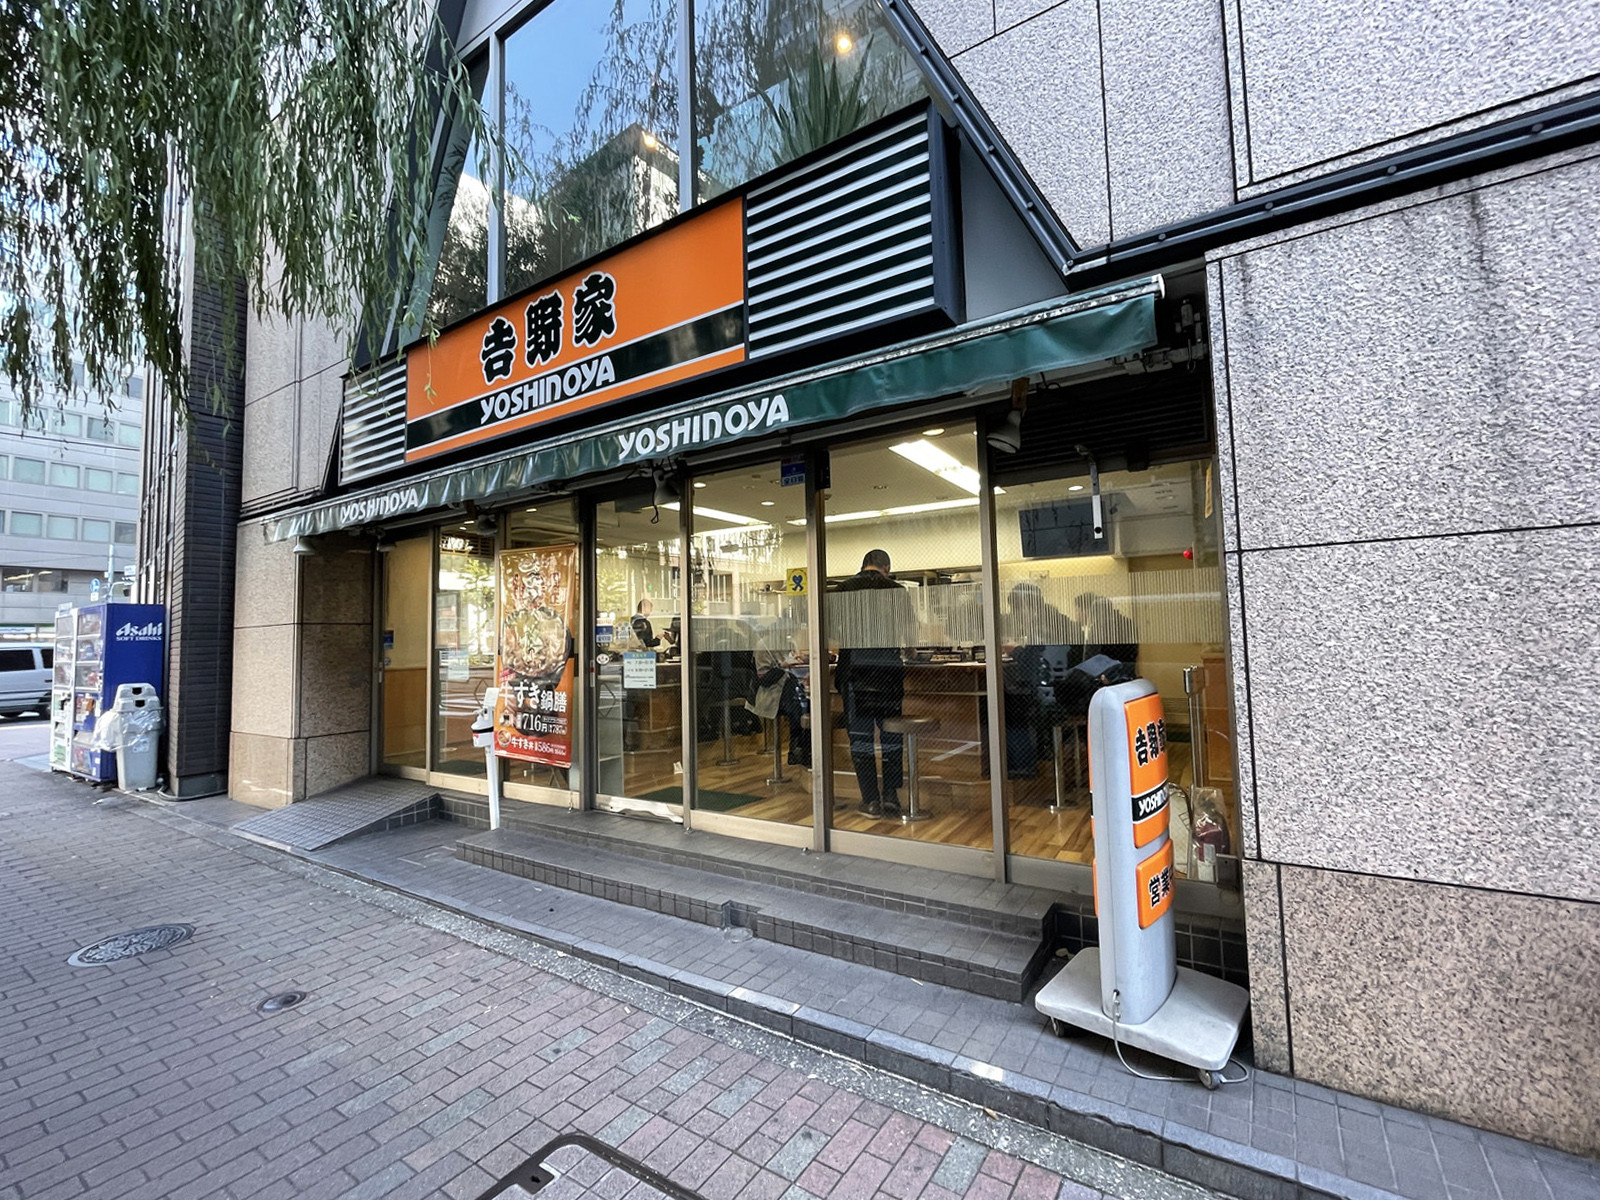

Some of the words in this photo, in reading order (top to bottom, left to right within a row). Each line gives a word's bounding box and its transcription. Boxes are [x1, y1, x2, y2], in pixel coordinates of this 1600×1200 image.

[481, 271, 617, 385] 吉野家
[480, 355, 616, 424] YOSHINOYA
[618, 394, 789, 460] YOSHINOYA
[340, 487, 419, 523] YOSHINOYA
[115, 622, 163, 636] Asahi
